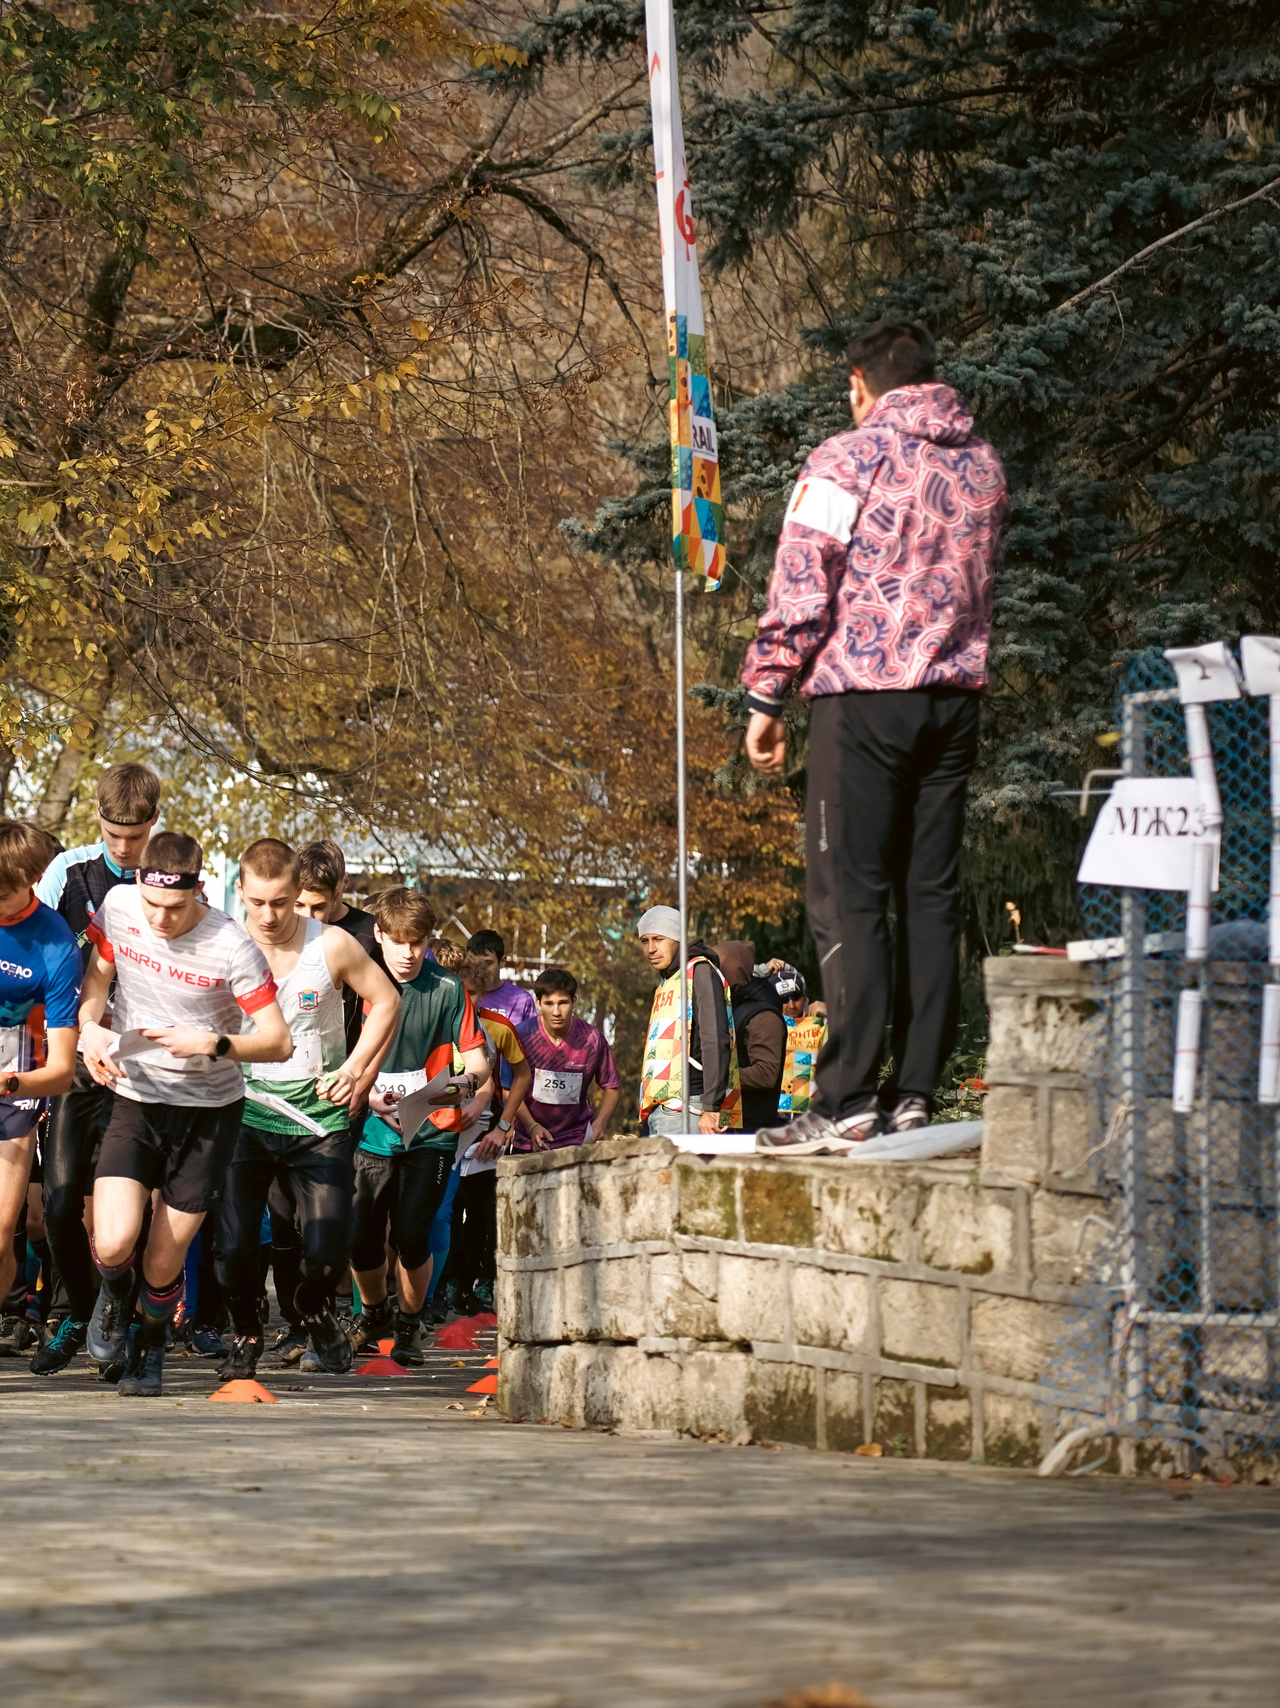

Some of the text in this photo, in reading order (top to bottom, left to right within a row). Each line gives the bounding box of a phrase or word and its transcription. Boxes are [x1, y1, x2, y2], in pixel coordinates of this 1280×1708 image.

[169, 966, 225, 988] WEST
[0, 1044, 5, 1053] 1
[304, 1050, 310, 1059] 1
[544, 1078, 567, 1090] 255
